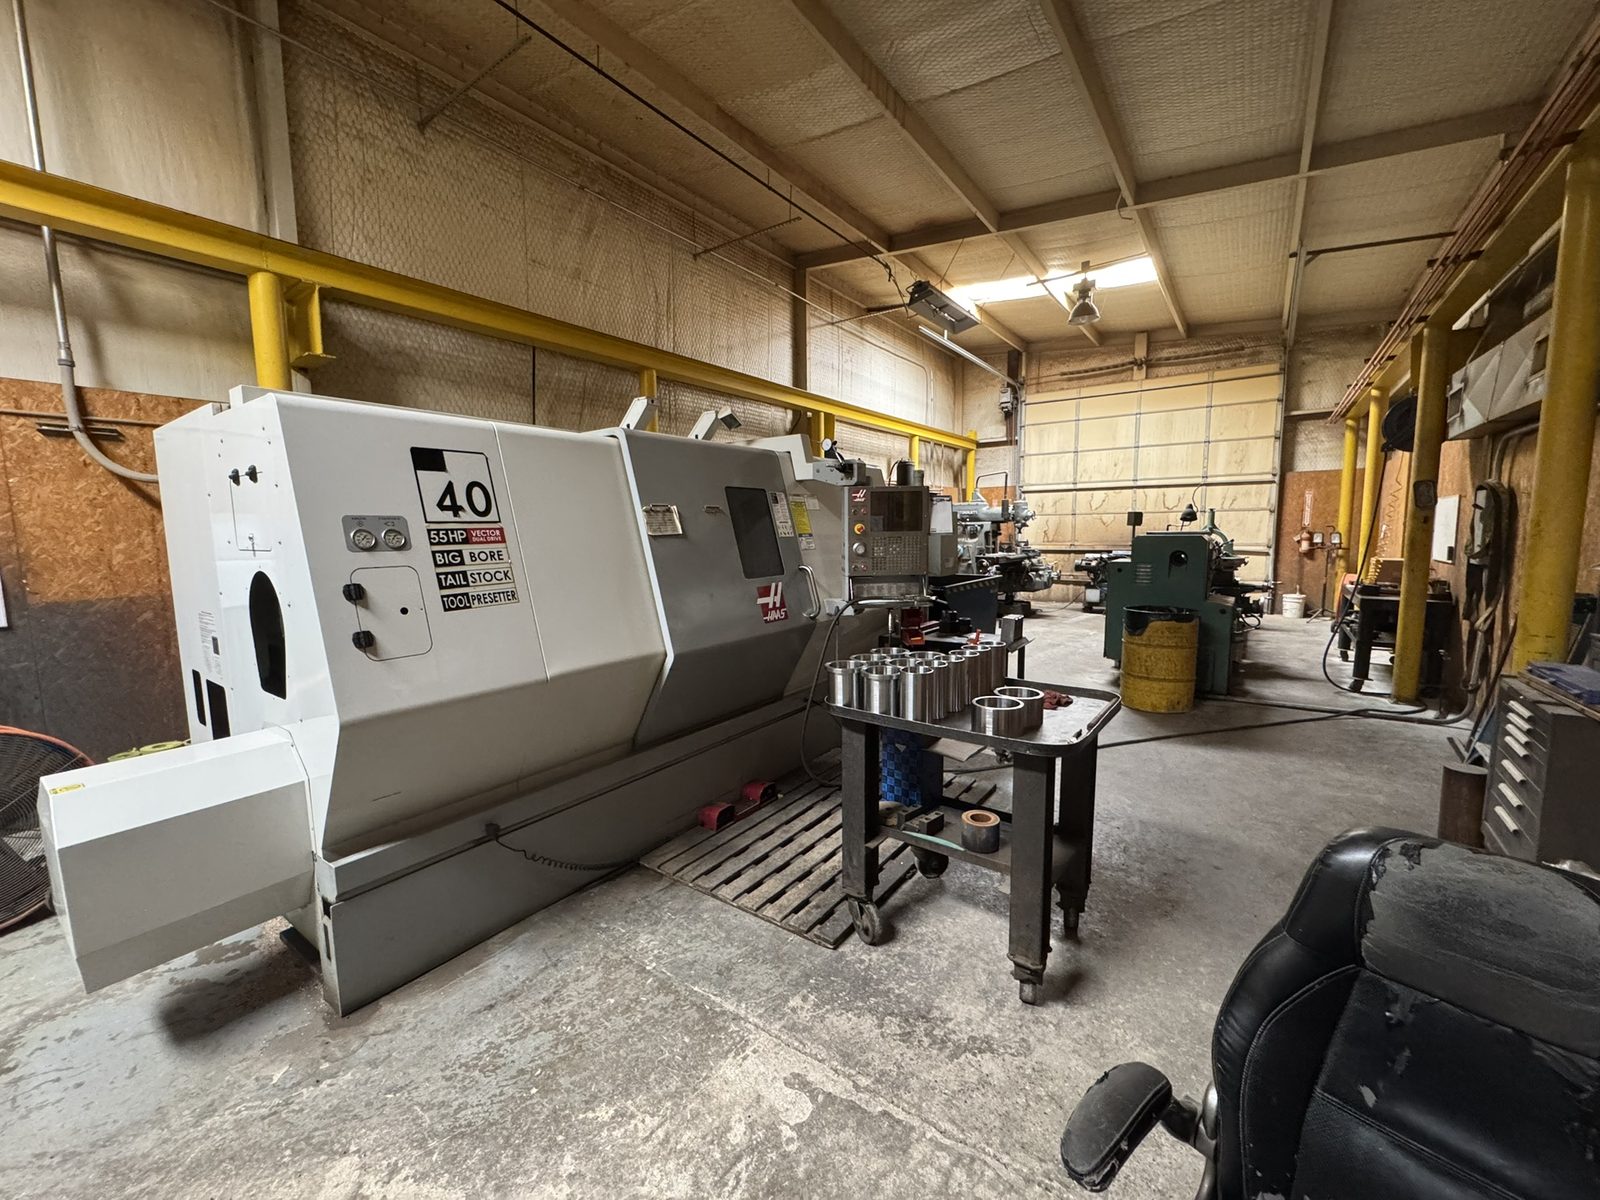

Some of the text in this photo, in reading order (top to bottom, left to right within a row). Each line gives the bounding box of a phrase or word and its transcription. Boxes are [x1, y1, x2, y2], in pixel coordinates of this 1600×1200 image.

[435, 480, 493, 518] 40
[430, 530, 467, 543] 55HP
[470, 529, 501, 537] VECTOR
[435, 550, 504, 565] BIG BORE
[439, 570, 512, 587] TAIL STOCK
[443, 590, 518, 609] TOOL PRESETTER
[763, 608, 787, 622] HAAS
